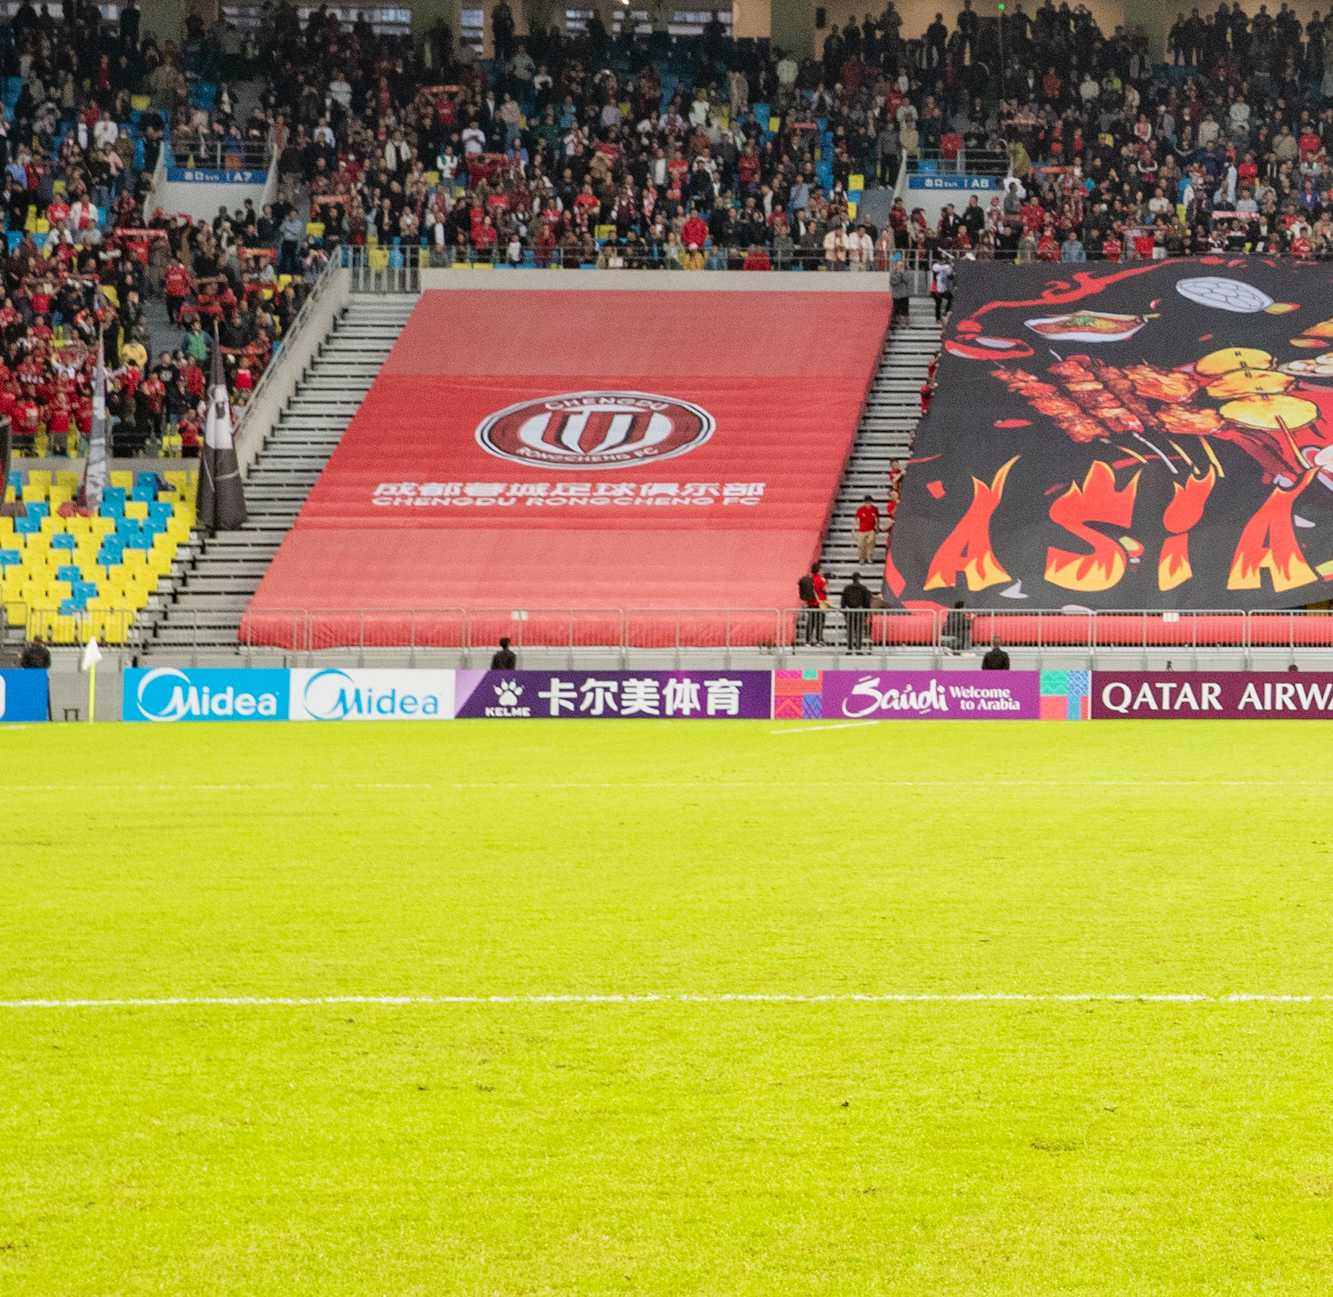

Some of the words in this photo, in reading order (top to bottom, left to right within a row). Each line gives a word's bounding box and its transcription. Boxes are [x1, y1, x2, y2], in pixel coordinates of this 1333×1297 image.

[545, 397, 669, 411] CHENGDU
[372, 497, 516, 507] CHENGDU
[525, 497, 715, 506] RONGCHENG
[723, 497, 761, 506] FC
[158, 685, 278, 717] Midea
[327, 687, 438, 715] Midea
[538, 678, 743, 716] 卡尔美体育
[842, 675, 949, 718] Saudi
[949, 686, 1010, 699] Welcome
[1102, 682, 1223, 713] QATAR
[485, 707, 530, 717] KELME
[960, 700, 974, 711] to
[977, 699, 1020, 711] Arabia
